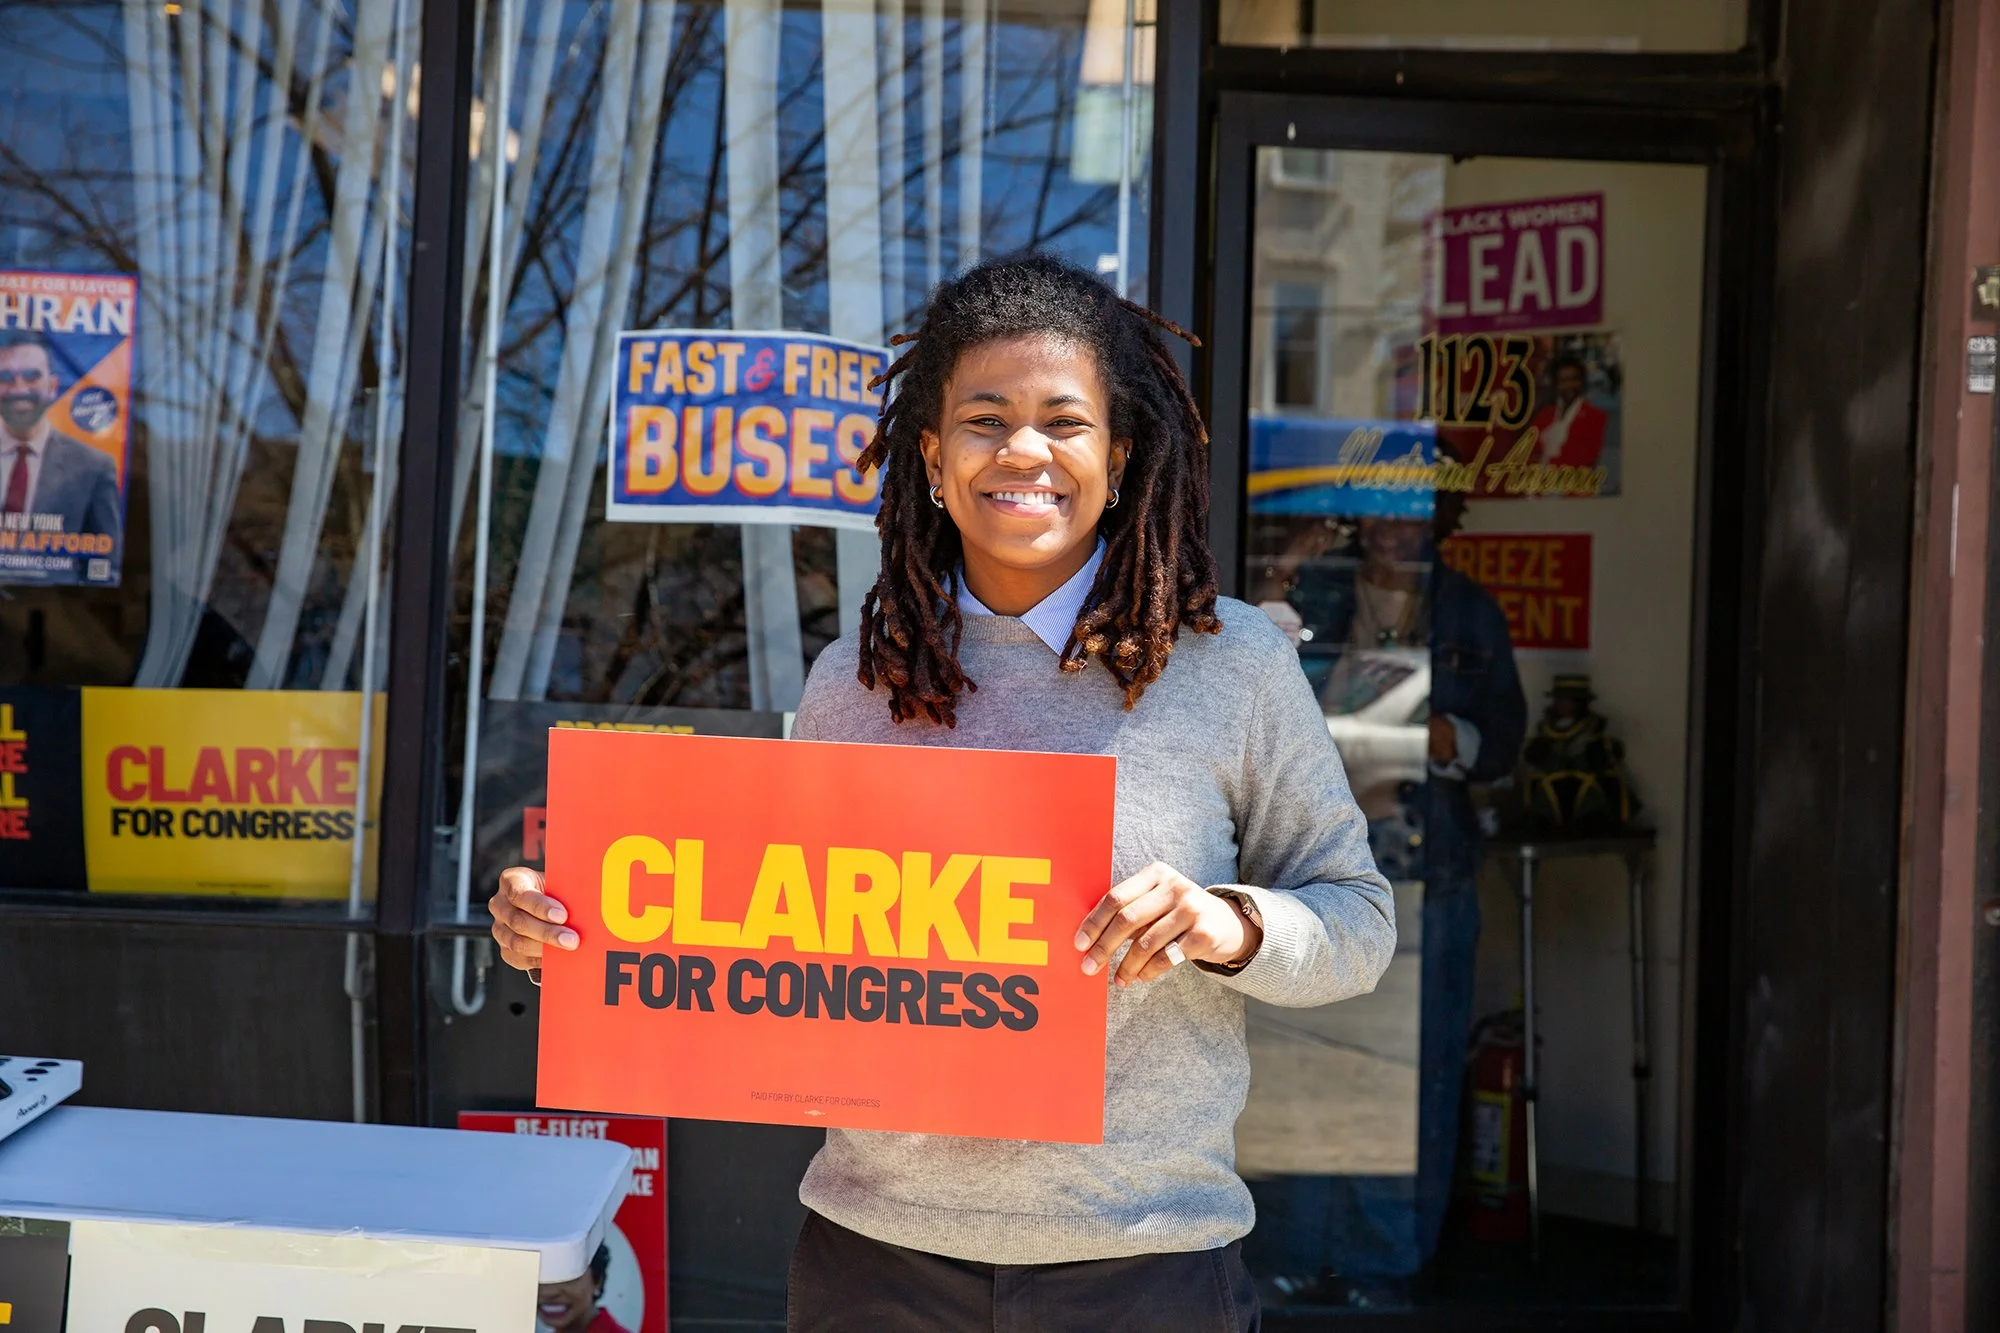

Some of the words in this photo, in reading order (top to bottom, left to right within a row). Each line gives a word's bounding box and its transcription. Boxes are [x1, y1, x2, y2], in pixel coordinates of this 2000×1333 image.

[1507, 201, 1598, 229] WOMEN
[1433, 225, 1599, 317] LEAD
[628, 341, 746, 395] FAST
[744, 347, 776, 392] &
[783, 343, 882, 407] FREE
[1414, 331, 1536, 430] 1123
[625, 405, 881, 504] BUSES
[5, 511, 31, 531] NEW
[32, 513, 64, 532] YORK
[21, 531, 113, 555] AFFORD
[106, 745, 360, 806] CLARKE
[111, 808, 173, 837] FOR
[181, 808, 355, 840] CONGRESS
[600, 834, 1052, 967] CLARKE
[604, 950, 716, 1012] FOR
[726, 958, 1040, 1032] CONGRESS
[514, 1118, 609, 1140] RE-ELECT
[750, 1091, 767, 1101] PAID
[768, 1092, 783, 1102] FOR
[784, 1093, 794, 1103] BY
[795, 1094, 824, 1105] CLARKE
[825, 1096, 840, 1106] FOR
[841, 1097, 881, 1108] CONGRESS
